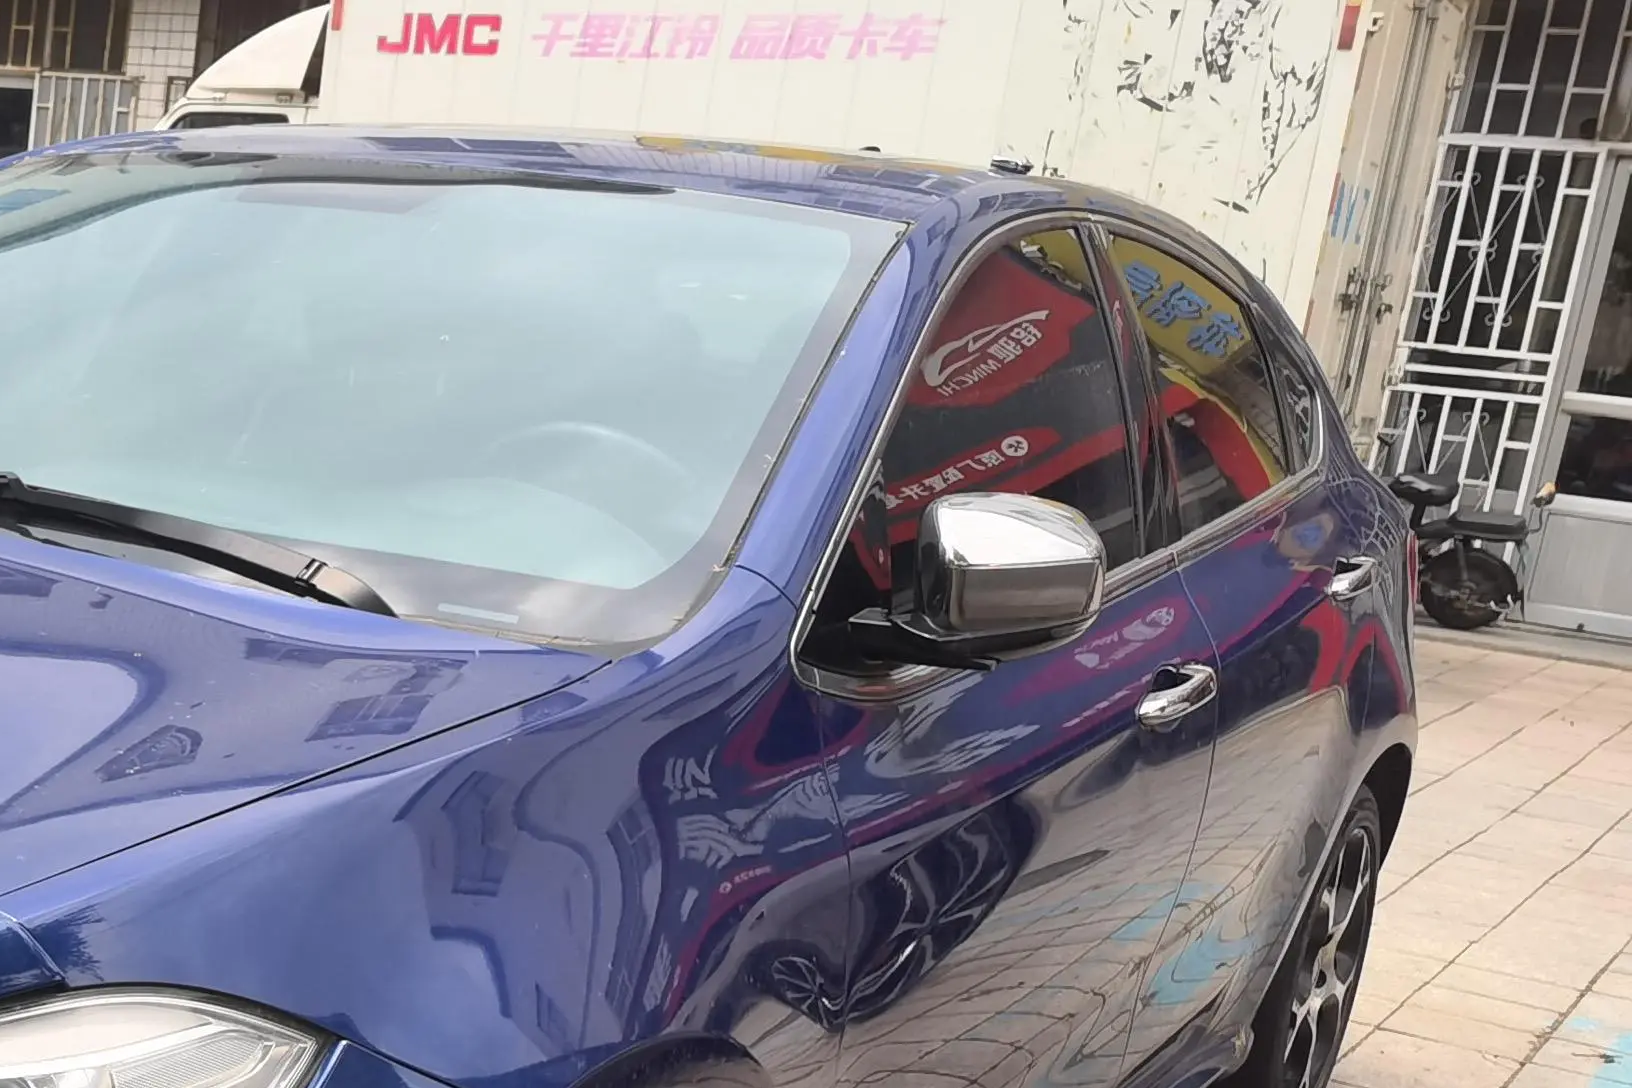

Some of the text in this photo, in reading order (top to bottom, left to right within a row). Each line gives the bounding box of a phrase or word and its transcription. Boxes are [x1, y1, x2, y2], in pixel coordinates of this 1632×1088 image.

[376, 13, 503, 56] JMC
[729, 12, 945, 61] 品质卡车
